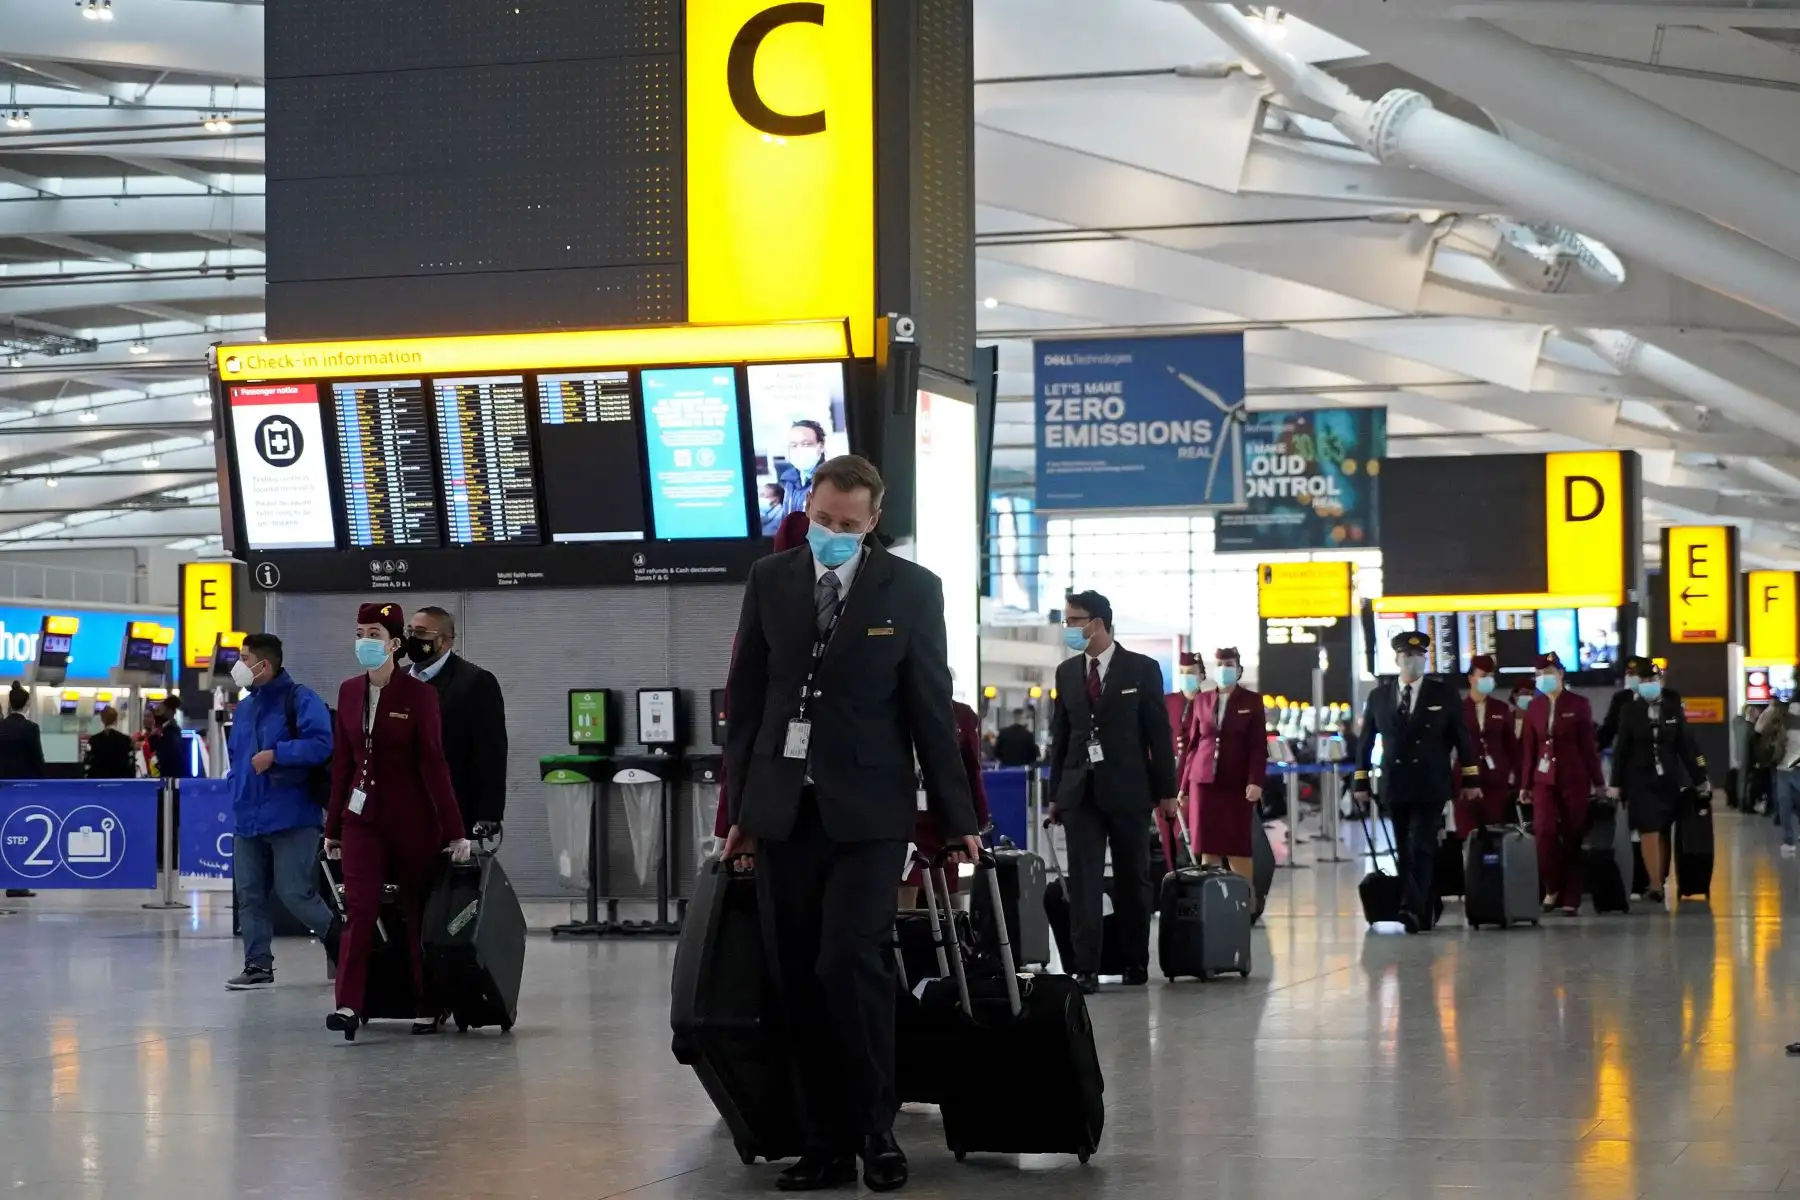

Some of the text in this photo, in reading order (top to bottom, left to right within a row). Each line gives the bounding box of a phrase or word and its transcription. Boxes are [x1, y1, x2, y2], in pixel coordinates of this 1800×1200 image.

[727, 1, 826, 136] C
[247, 351, 422, 370] Check-in information
[240, 386, 299, 397] Passenger notice
[1044, 381, 1123, 396] LET'S MAKE
[1044, 397, 1125, 422] ZERO
[1044, 419, 1213, 448] EMISSIONS
[1246, 455, 1306, 477] OUD
[1246, 475, 1342, 498] ONTROL
[1564, 475, 1604, 523] D
[1688, 544, 1709, 578] E
[200, 579, 217, 610] E
[1764, 585, 1779, 613] F
[6, 813, 54, 866] STEP 2
